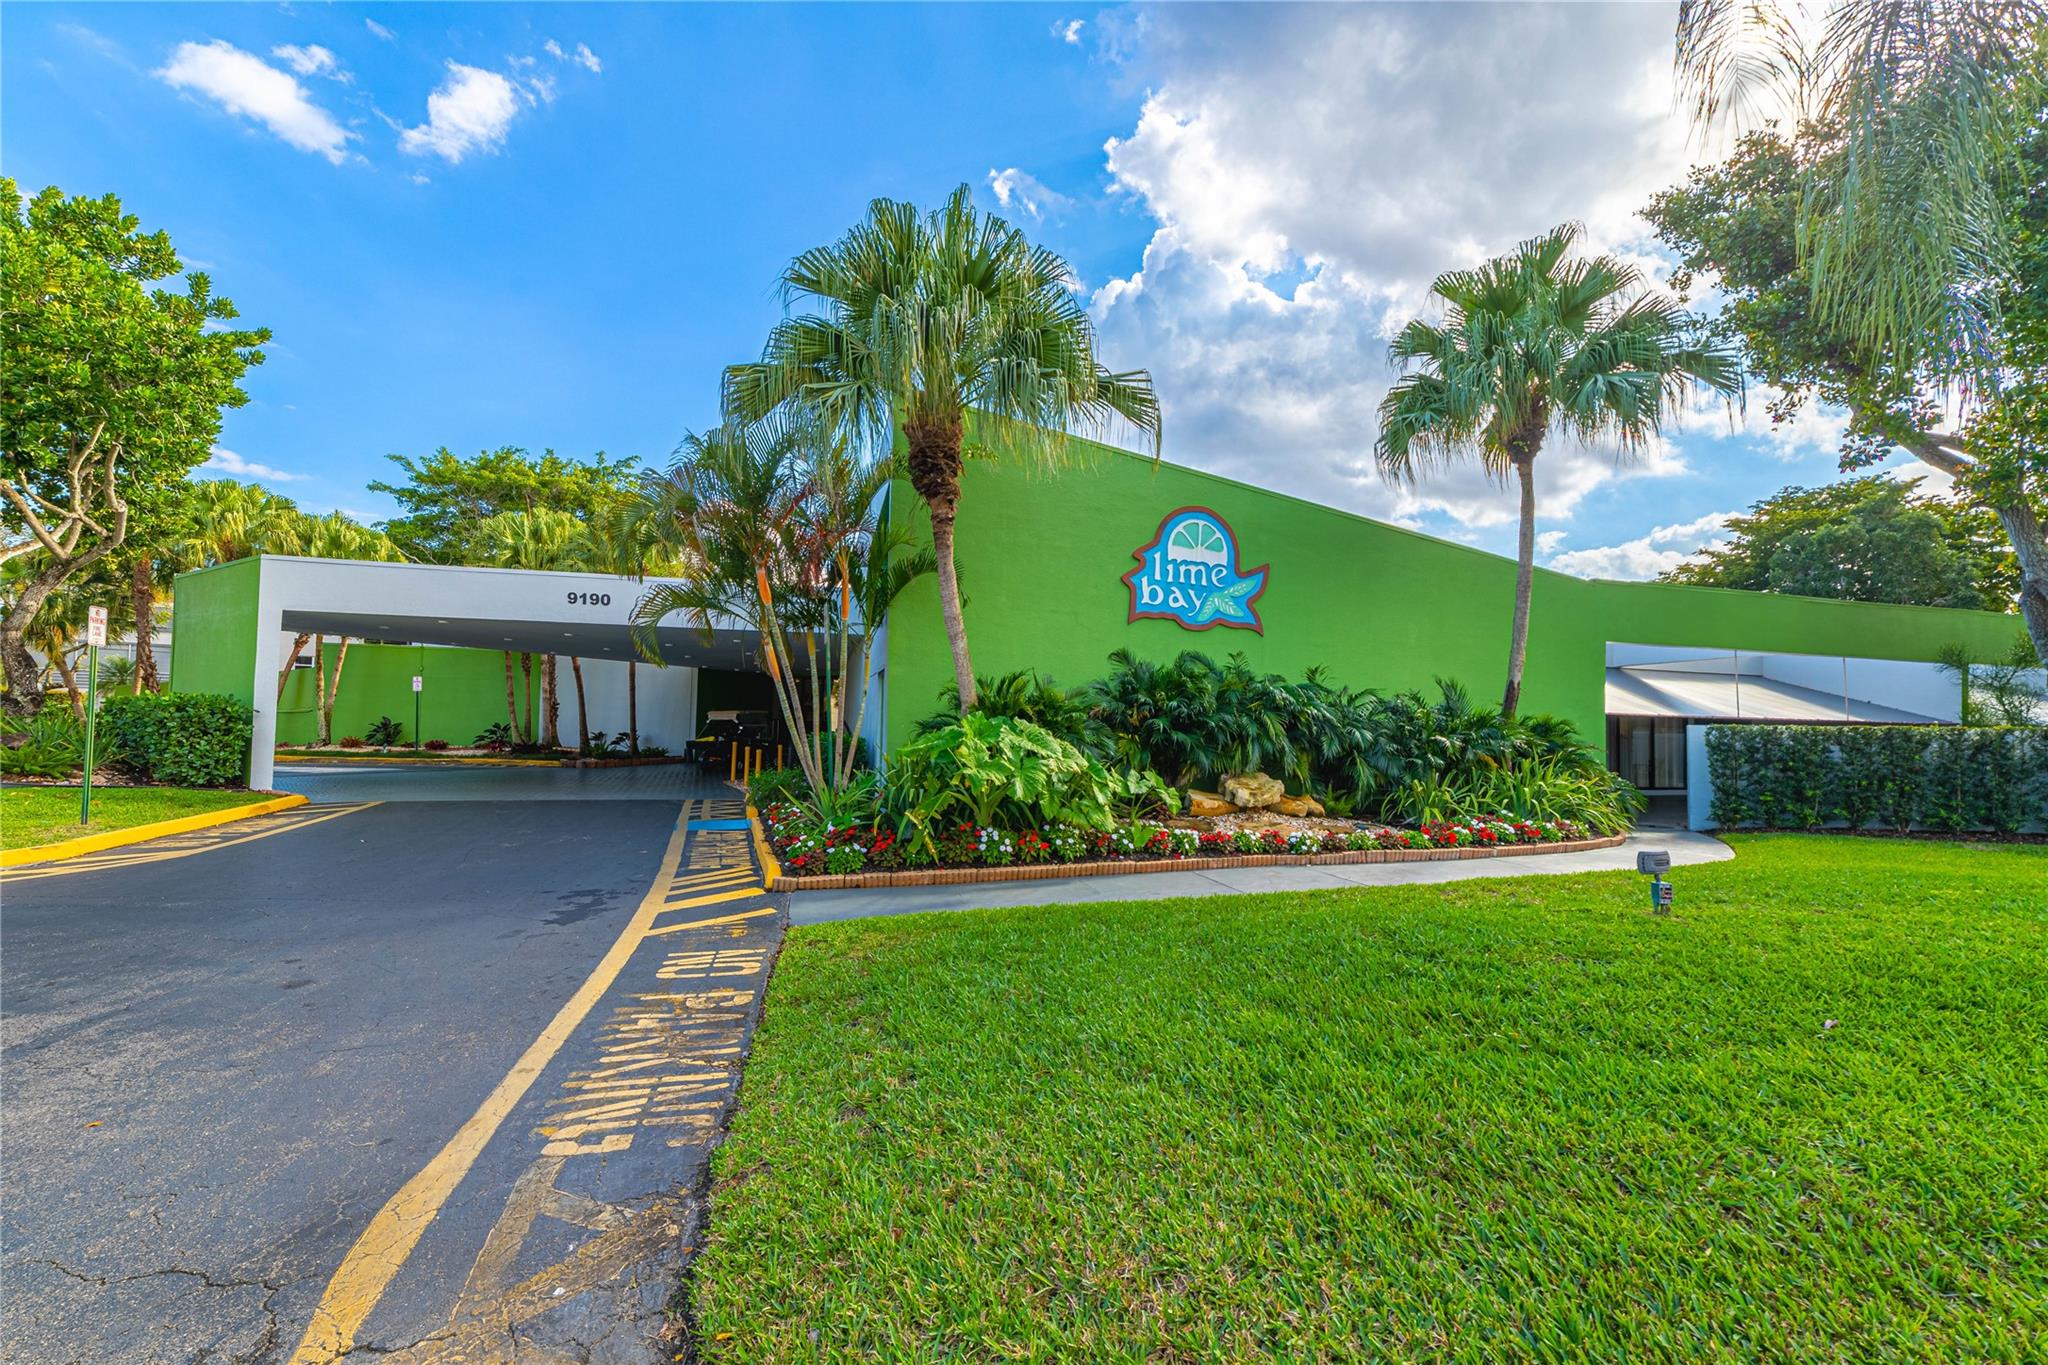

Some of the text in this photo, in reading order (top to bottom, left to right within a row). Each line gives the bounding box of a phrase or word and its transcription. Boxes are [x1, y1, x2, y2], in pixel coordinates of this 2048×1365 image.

[1154, 551, 1227, 588] lime
[567, 591, 611, 606] 9190
[1141, 575, 1206, 616] bay
